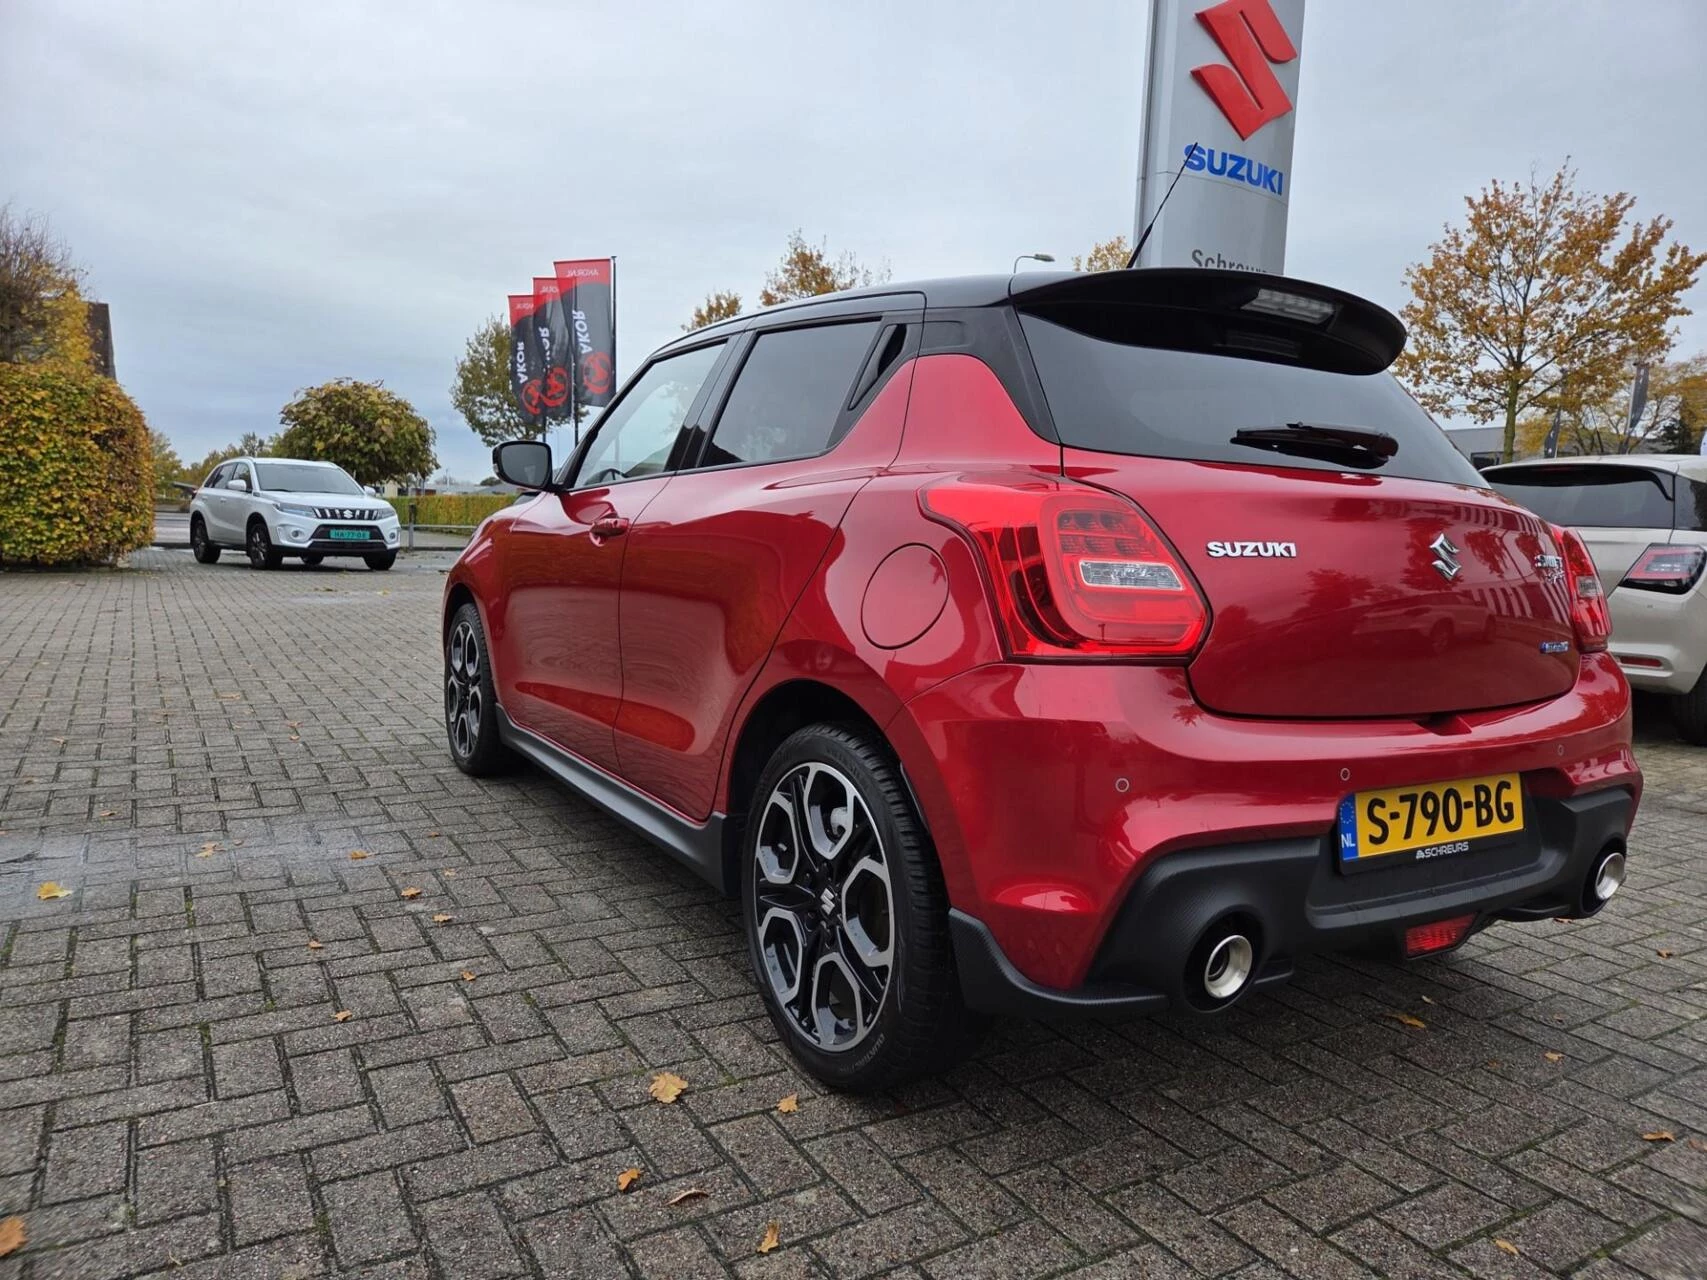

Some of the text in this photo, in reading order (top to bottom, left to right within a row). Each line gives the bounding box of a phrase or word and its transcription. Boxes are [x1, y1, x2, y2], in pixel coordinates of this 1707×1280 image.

[1183, 143, 1284, 196] SUZUKI
[1191, 249, 1267, 273] Schr
[1207, 541, 1297, 558] SUZUKI
[1366, 780, 1515, 846] S-790-BG
[1340, 832, 1356, 849] NL
[1424, 841, 1469, 858] SCHREURS
